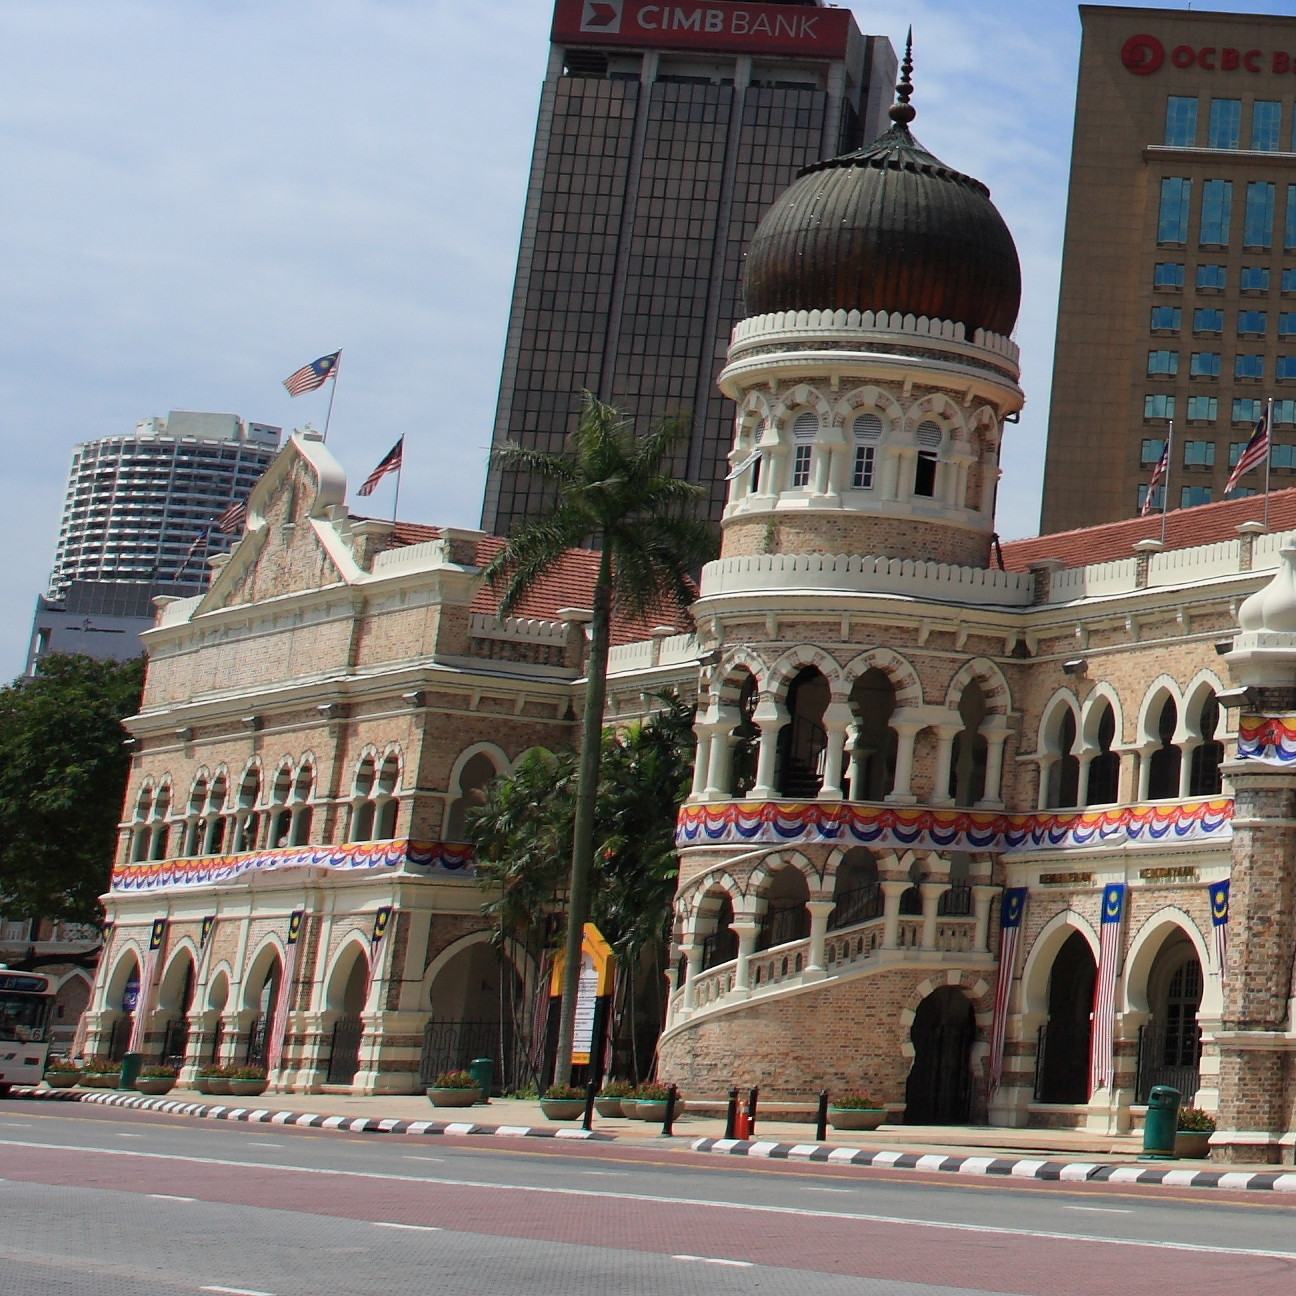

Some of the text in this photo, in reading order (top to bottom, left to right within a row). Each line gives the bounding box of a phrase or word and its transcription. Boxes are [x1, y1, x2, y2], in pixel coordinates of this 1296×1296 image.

[636, 4, 820, 40] CIMB BANK
[1171, 44, 1263, 74] OCBC
